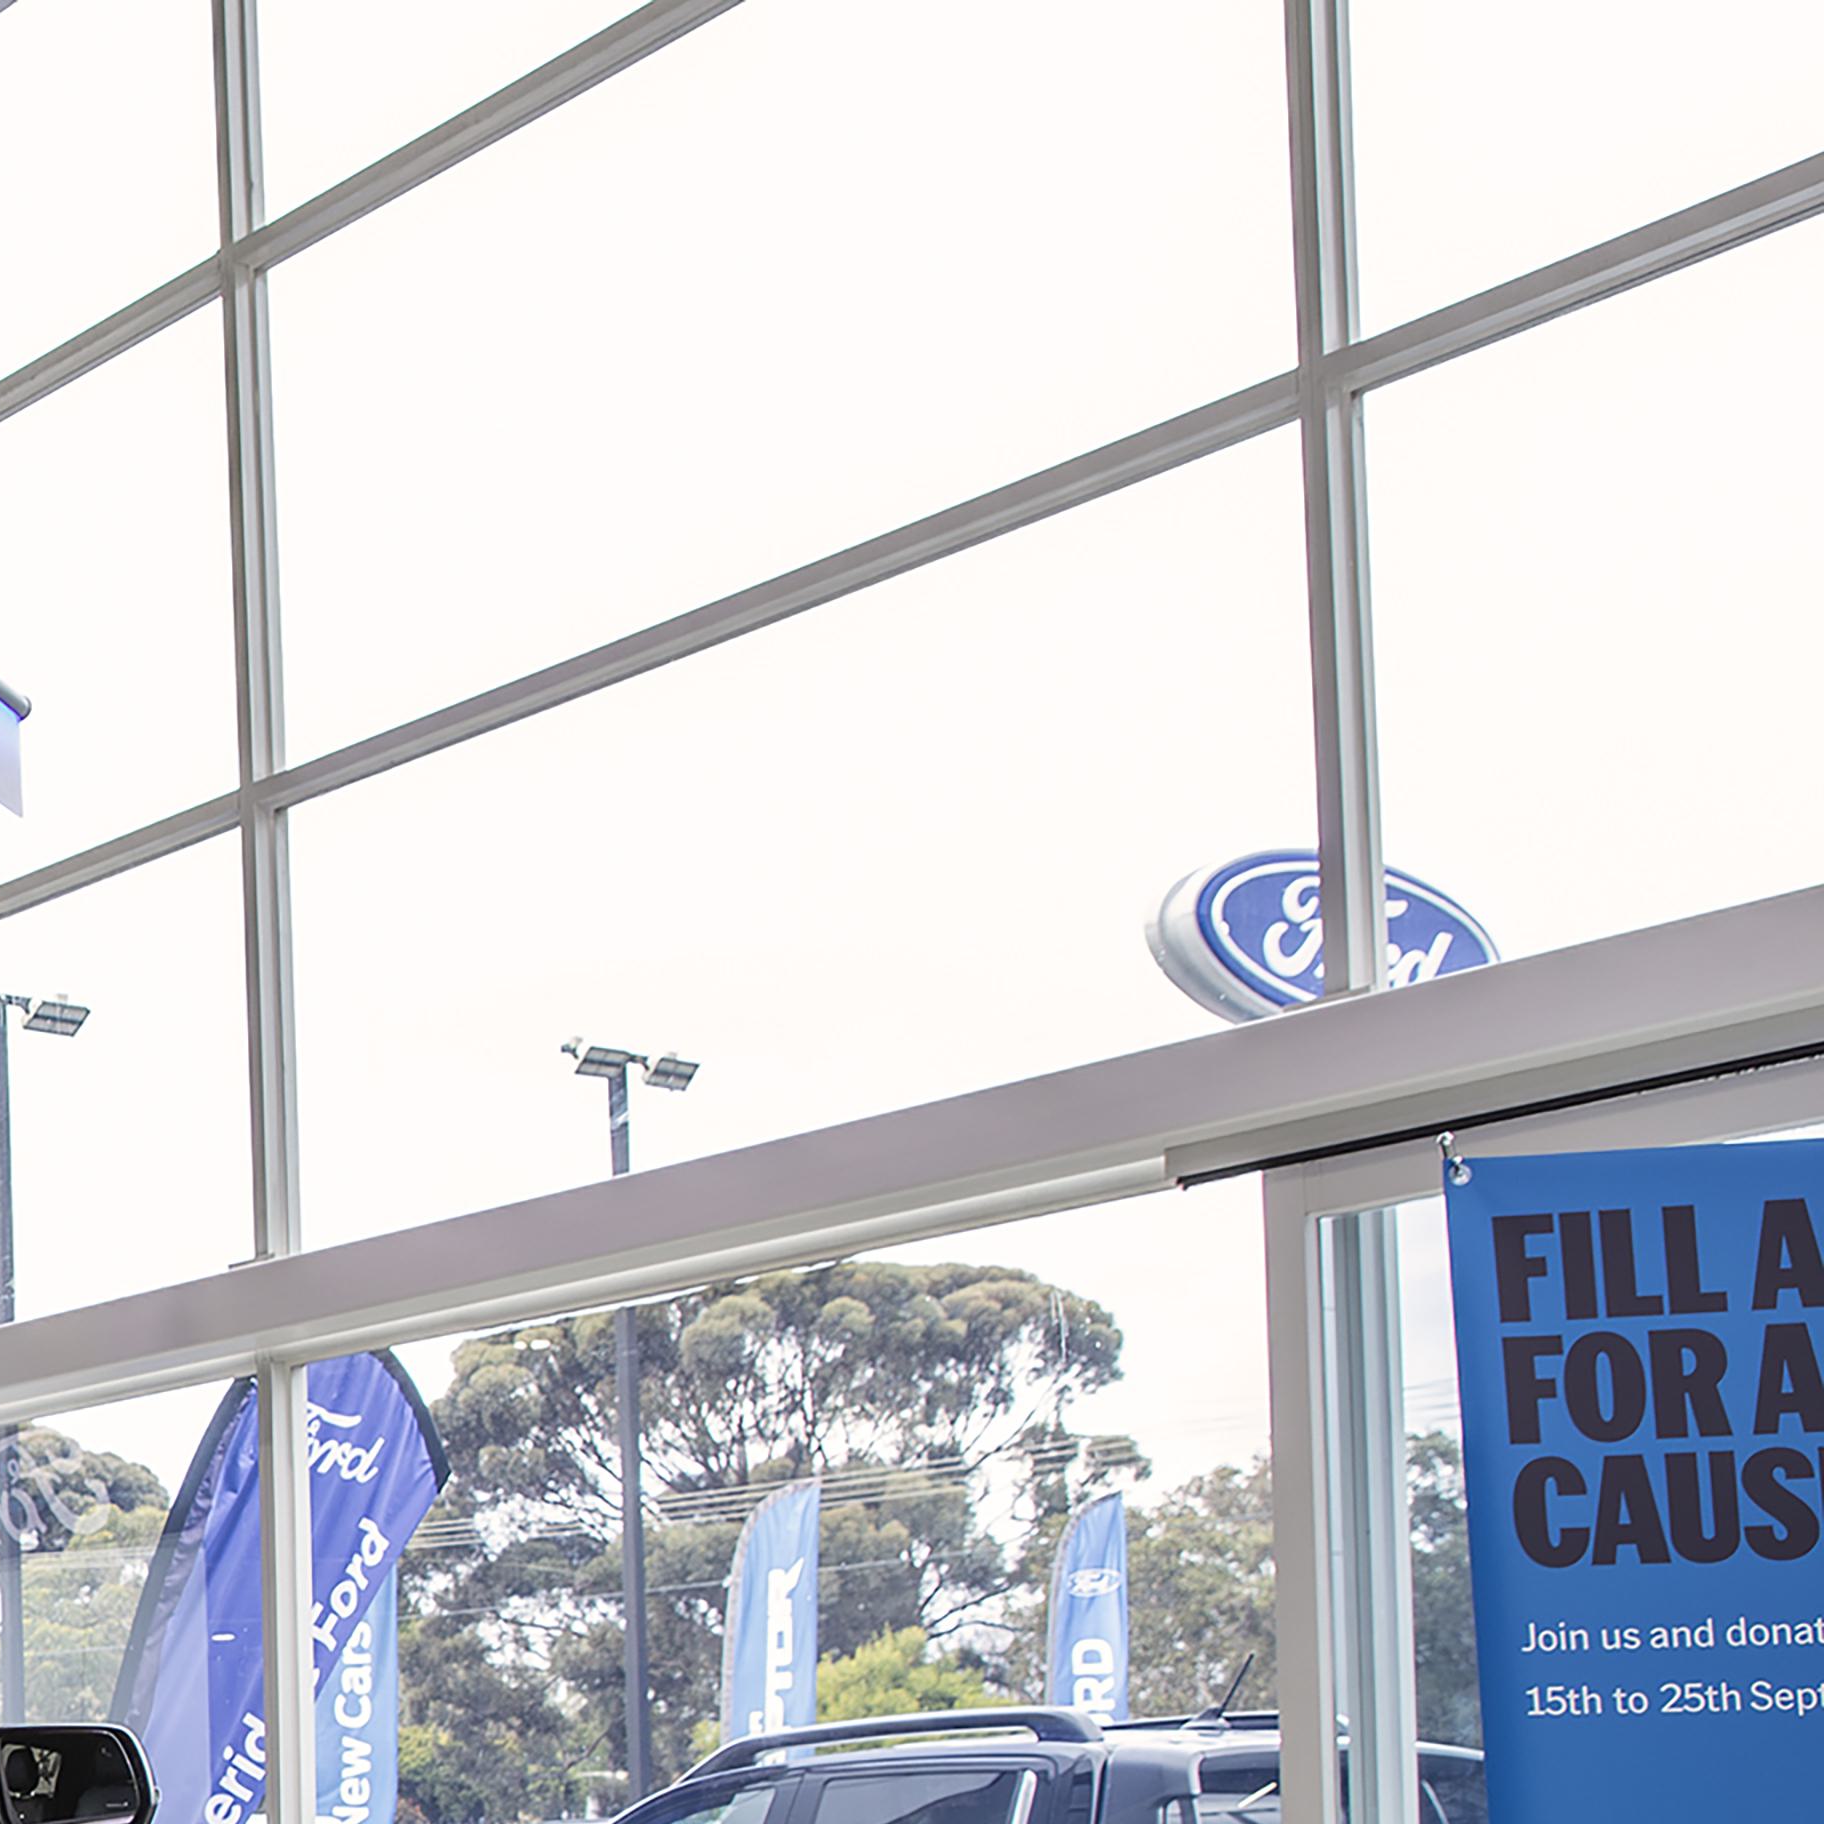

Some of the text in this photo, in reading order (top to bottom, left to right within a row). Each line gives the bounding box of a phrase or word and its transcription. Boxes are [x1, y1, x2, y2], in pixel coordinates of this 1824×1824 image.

[1492, 1198, 1824, 1323] FILL A
[1501, 1322, 1824, 1445] FOR A
[307, 1400, 385, 1483] ord
[1513, 1447, 1824, 1569] CAUS
[333, 1621, 373, 1730] Cars
[1521, 1621, 1589, 1653] Join
[1600, 1622, 1642, 1651] us
[1649, 1617, 1716, 1650] and
[1525, 1684, 1603, 1717] 15th
[1612, 1687, 1649, 1715] to
[1660, 1681, 1742, 1715] 25th
